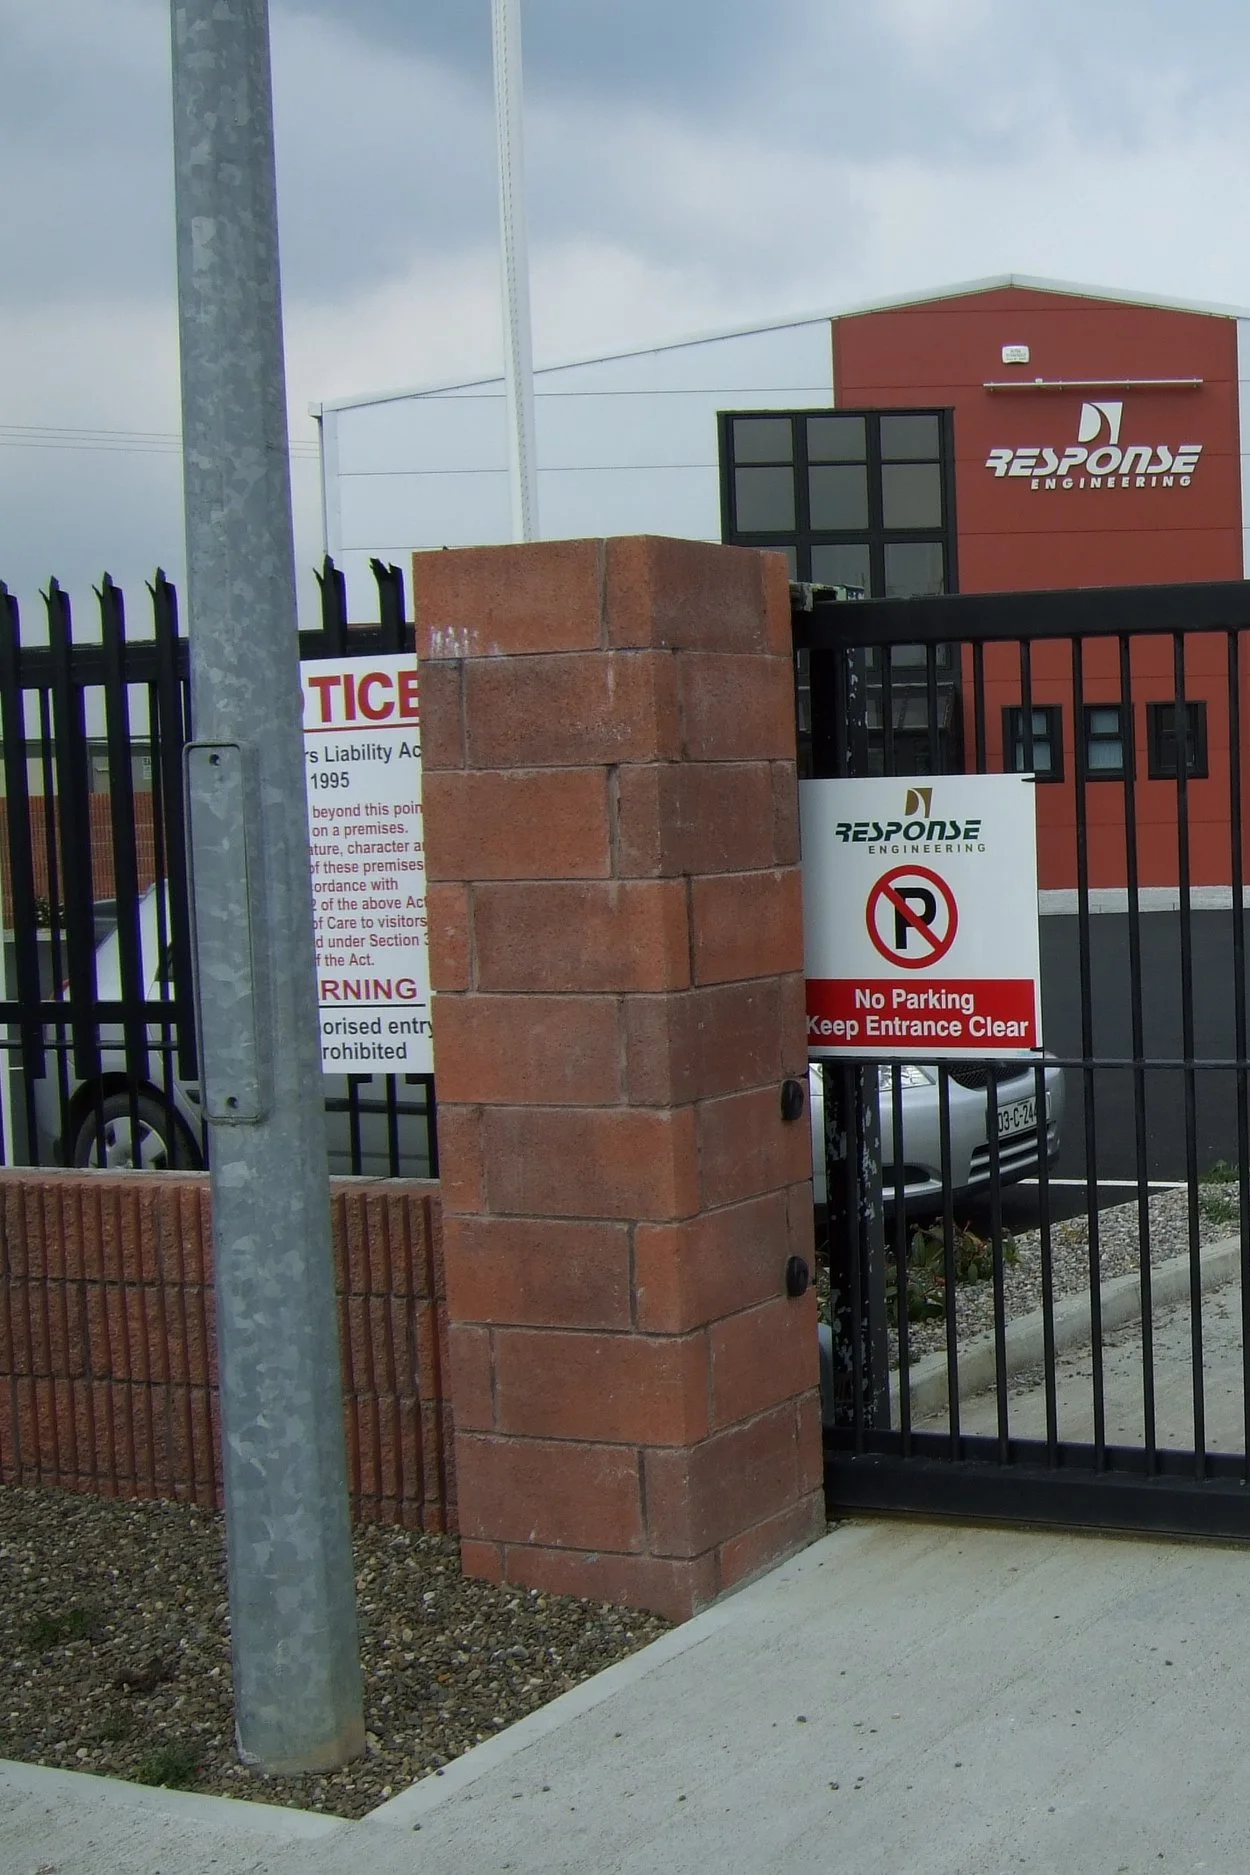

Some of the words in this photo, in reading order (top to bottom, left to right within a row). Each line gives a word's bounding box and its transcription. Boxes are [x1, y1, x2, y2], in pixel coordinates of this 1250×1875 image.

[985, 445, 1203, 477] RESPONSE
[1031, 476, 1192, 490] ENGINEERING
[302, 669, 420, 723] TICE
[324, 743, 393, 764] Liability
[398, 741, 422, 758] Ac
[310, 771, 350, 789] 1995
[312, 803, 361, 821] beyond
[364, 802, 390, 817] this
[394, 801, 423, 818] poin
[312, 825, 328, 837] on
[332, 825, 340, 837] a
[344, 821, 409, 839] premises.
[835, 820, 982, 843] RESPONSE
[347, 840, 410, 854] character
[868, 843, 986, 855] ENGINEERING
[323, 860, 359, 874] these
[363, 858, 424, 876] premises
[312, 879, 367, 893] ordance
[371, 877, 399, 891] with
[321, 898, 334, 911] of
[337, 897, 358, 911] the
[362, 896, 402, 910] above
[327, 916, 357, 930] Care
[361, 915, 374, 929] to
[378, 914, 428, 928] visitors
[328, 935, 366, 948] under
[369, 933, 420, 947] Section
[324, 953, 345, 967] the
[349, 953, 375, 967] Act.
[320, 978, 417, 1001] RNING
[855, 989, 885, 1010] No
[892, 989, 975, 1015] Parking
[322, 1017, 382, 1035] orised
[807, 1015, 859, 1041] Keep
[866, 1015, 963, 1037] Entrance
[969, 1016, 1029, 1038] Clear
[322, 1042, 408, 1060] rohibited
